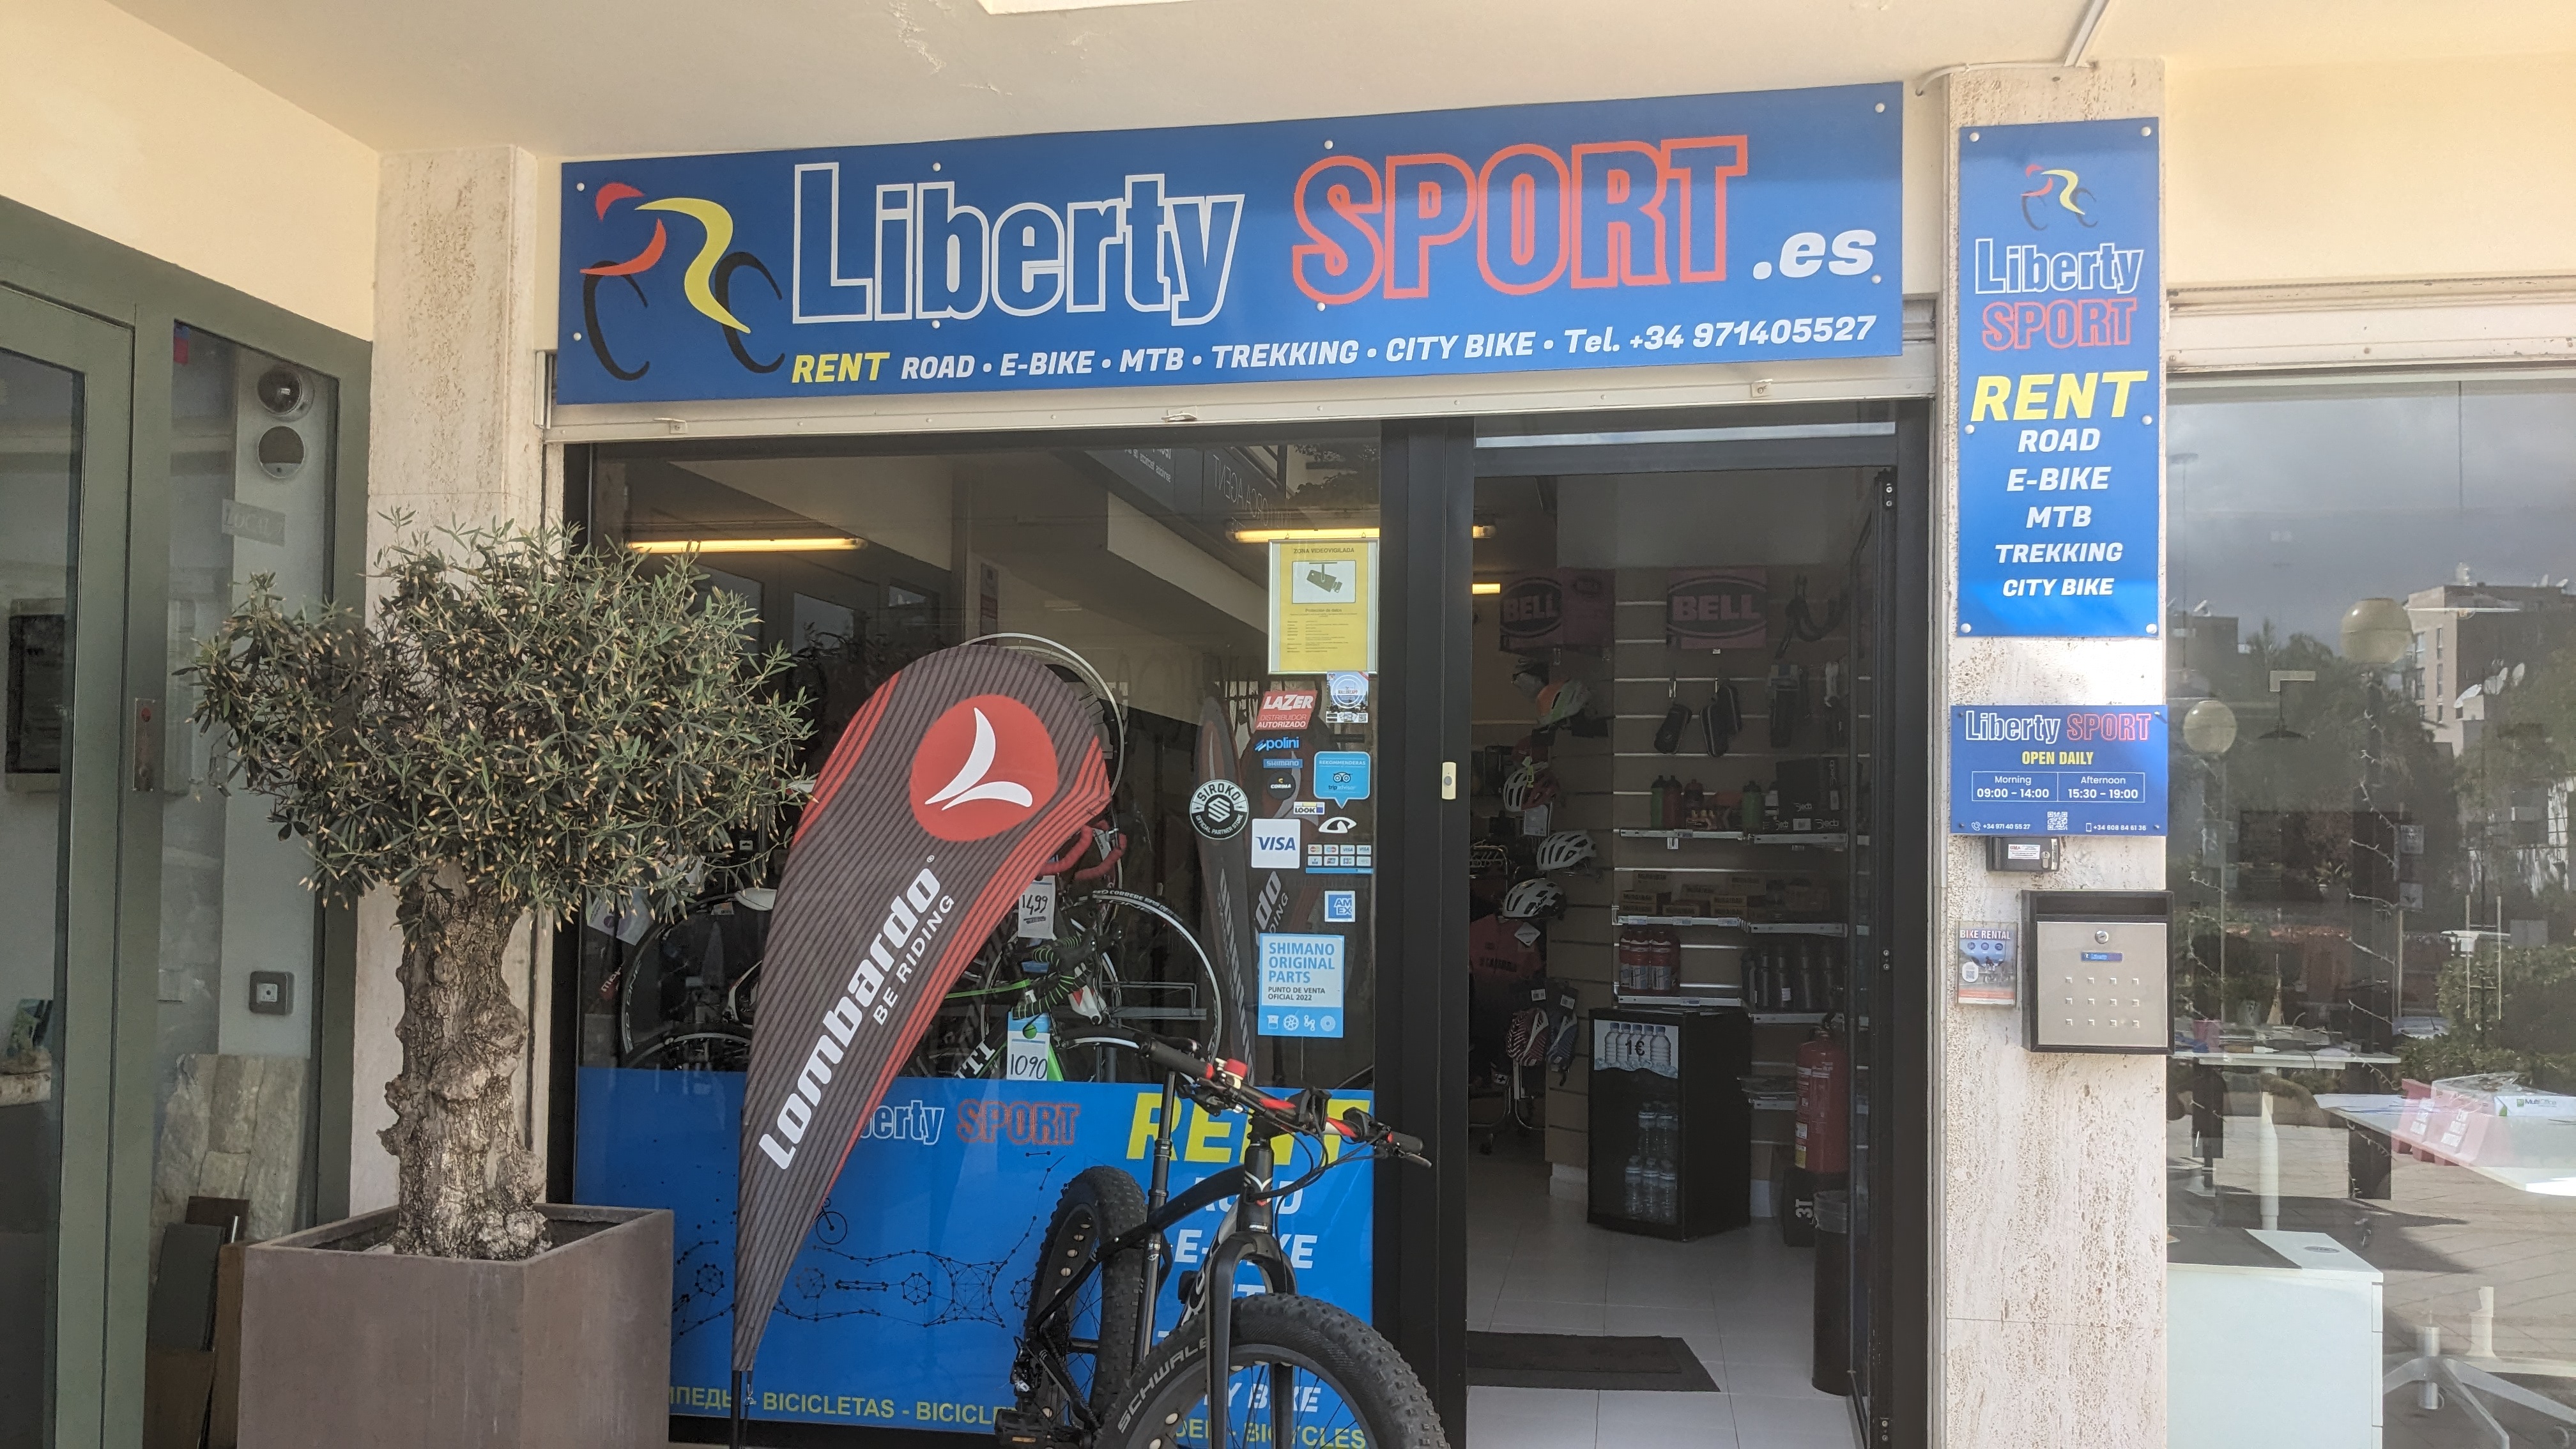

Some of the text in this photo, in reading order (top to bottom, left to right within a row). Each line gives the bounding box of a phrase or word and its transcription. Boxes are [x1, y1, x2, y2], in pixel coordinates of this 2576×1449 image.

[792, 135, 1878, 327] Liberty SPORT .es
[1975, 238, 2144, 295] Liberty
[1982, 297, 2138, 351] SPORT
[792, 314, 1876, 384] RENT ROAD E-BIKE MTB TREKKING CITY BIKE Tel. +34 971405527
[1970, 371, 2149, 422] RENT
[2018, 427, 2101, 453] ROAD
[2006, 466, 2112, 492] E-BIKE
[2026, 505, 2092, 528] MTB
[1995, 542, 2123, 564] TREKKING
[2002, 578, 2114, 597] CITY BIKE
[1503, 593, 1559, 623] BELL
[1672, 594, 1761, 621] BELL
[1263, 694, 1314, 710] LAZER
[1965, 710, 2151, 744] Liberty SPORT
[1266, 736, 1300, 751] polini
[2022, 751, 2094, 765] OPEN DAILY
[1995, 776, 2032, 786] Morning
[2080, 776, 2126, 785] Afternoon
[1197, 783, 1241, 802] SIROKO
[1977, 788, 2008, 798] 09:00
[2020, 788, 2050, 798] 14:00
[2067, 788, 2097, 799] 15:30
[2109, 788, 2138, 799] 19:00
[1211, 827, 1234, 835] PARTNER
[1231, 813, 1243, 829] STORE
[1255, 836, 1296, 851] VISA
[1022, 894, 1048, 916] 1499
[1959, 930, 2011, 940] BIKE RENTAL
[873, 894, 955, 1025] BE RIDING
[1269, 942, 1335, 956] SHIMANO
[1269, 956, 1335, 970] ORIGINAL
[1268, 970, 1311, 983] PARTS
[758, 868, 941, 1170] Lombardo
[1625, 1040, 1645, 1057] 1€
[1010, 1054, 1048, 1080] 1090
[957, 1099, 1082, 1145] SPORT
[762, 1392, 894, 1419] BICICLETAS
